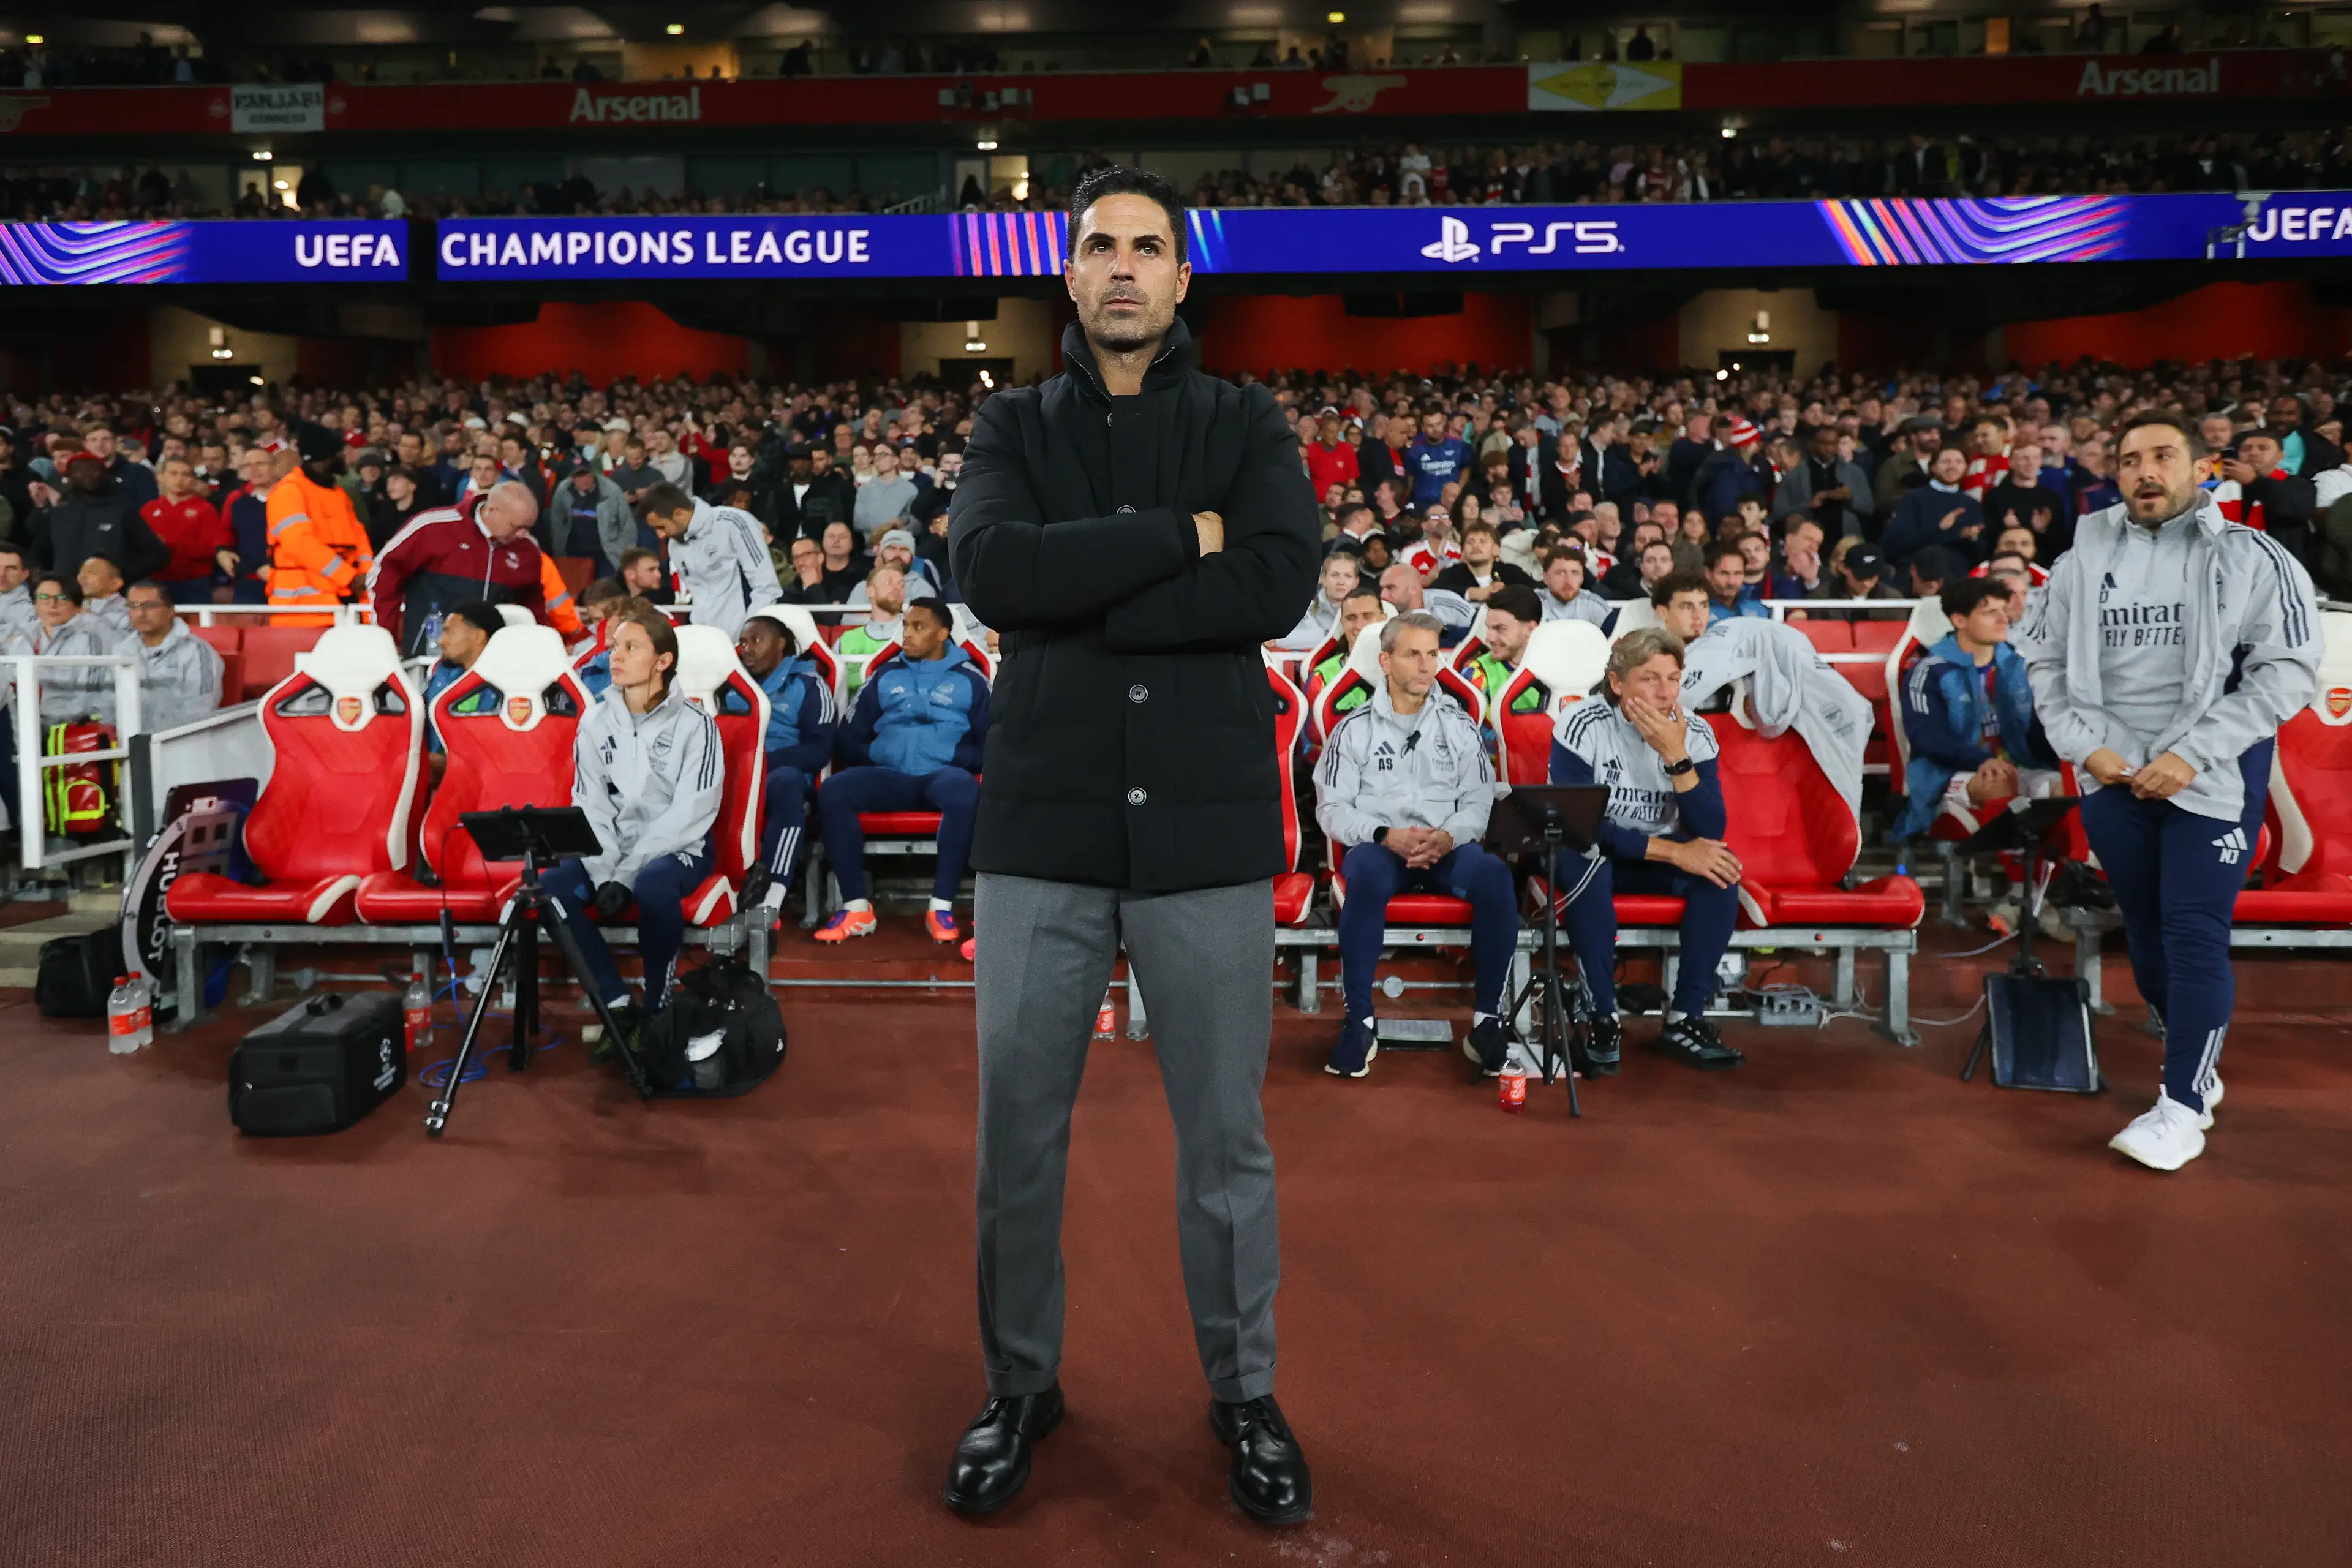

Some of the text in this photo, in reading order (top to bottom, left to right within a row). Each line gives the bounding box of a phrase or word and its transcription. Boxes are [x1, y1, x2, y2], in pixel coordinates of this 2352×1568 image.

[2078, 58, 2220, 96] Arsenal
[570, 85, 702, 123] Arsenal
[295, 230, 870, 267] UEFA CHAMPIONS LEAGUE
[1491, 221, 1618, 254] PS5
[2098, 601, 2185, 627] mirat
[2105, 627, 2187, 647] FLY BETTE
[1378, 758, 1393, 772] AS
